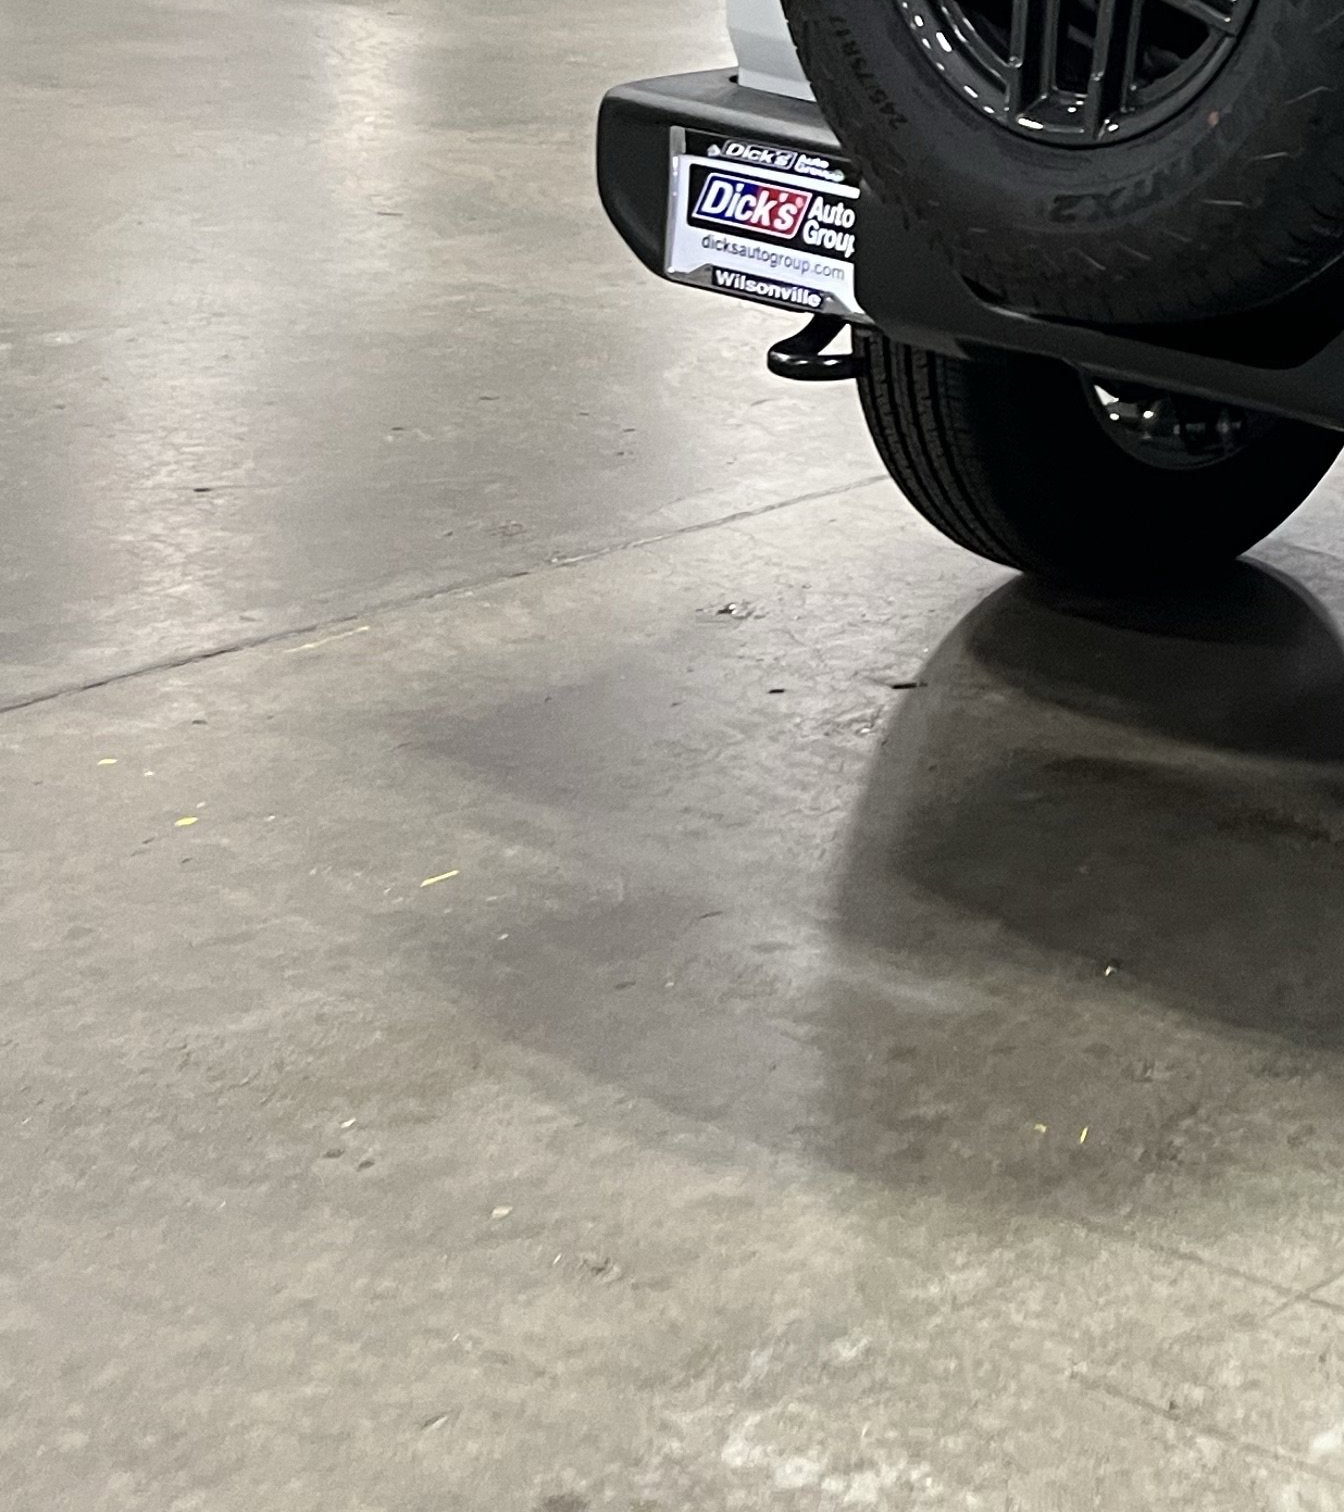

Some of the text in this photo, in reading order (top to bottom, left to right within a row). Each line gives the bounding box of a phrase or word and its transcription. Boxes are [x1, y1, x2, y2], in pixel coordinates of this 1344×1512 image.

[725, 142, 790, 167] Dick's
[701, 179, 799, 232] Dick's
[807, 196, 856, 229] Auto
[701, 233, 846, 281] dicksautogroup.com
[714, 268, 822, 308] Wilsonville
